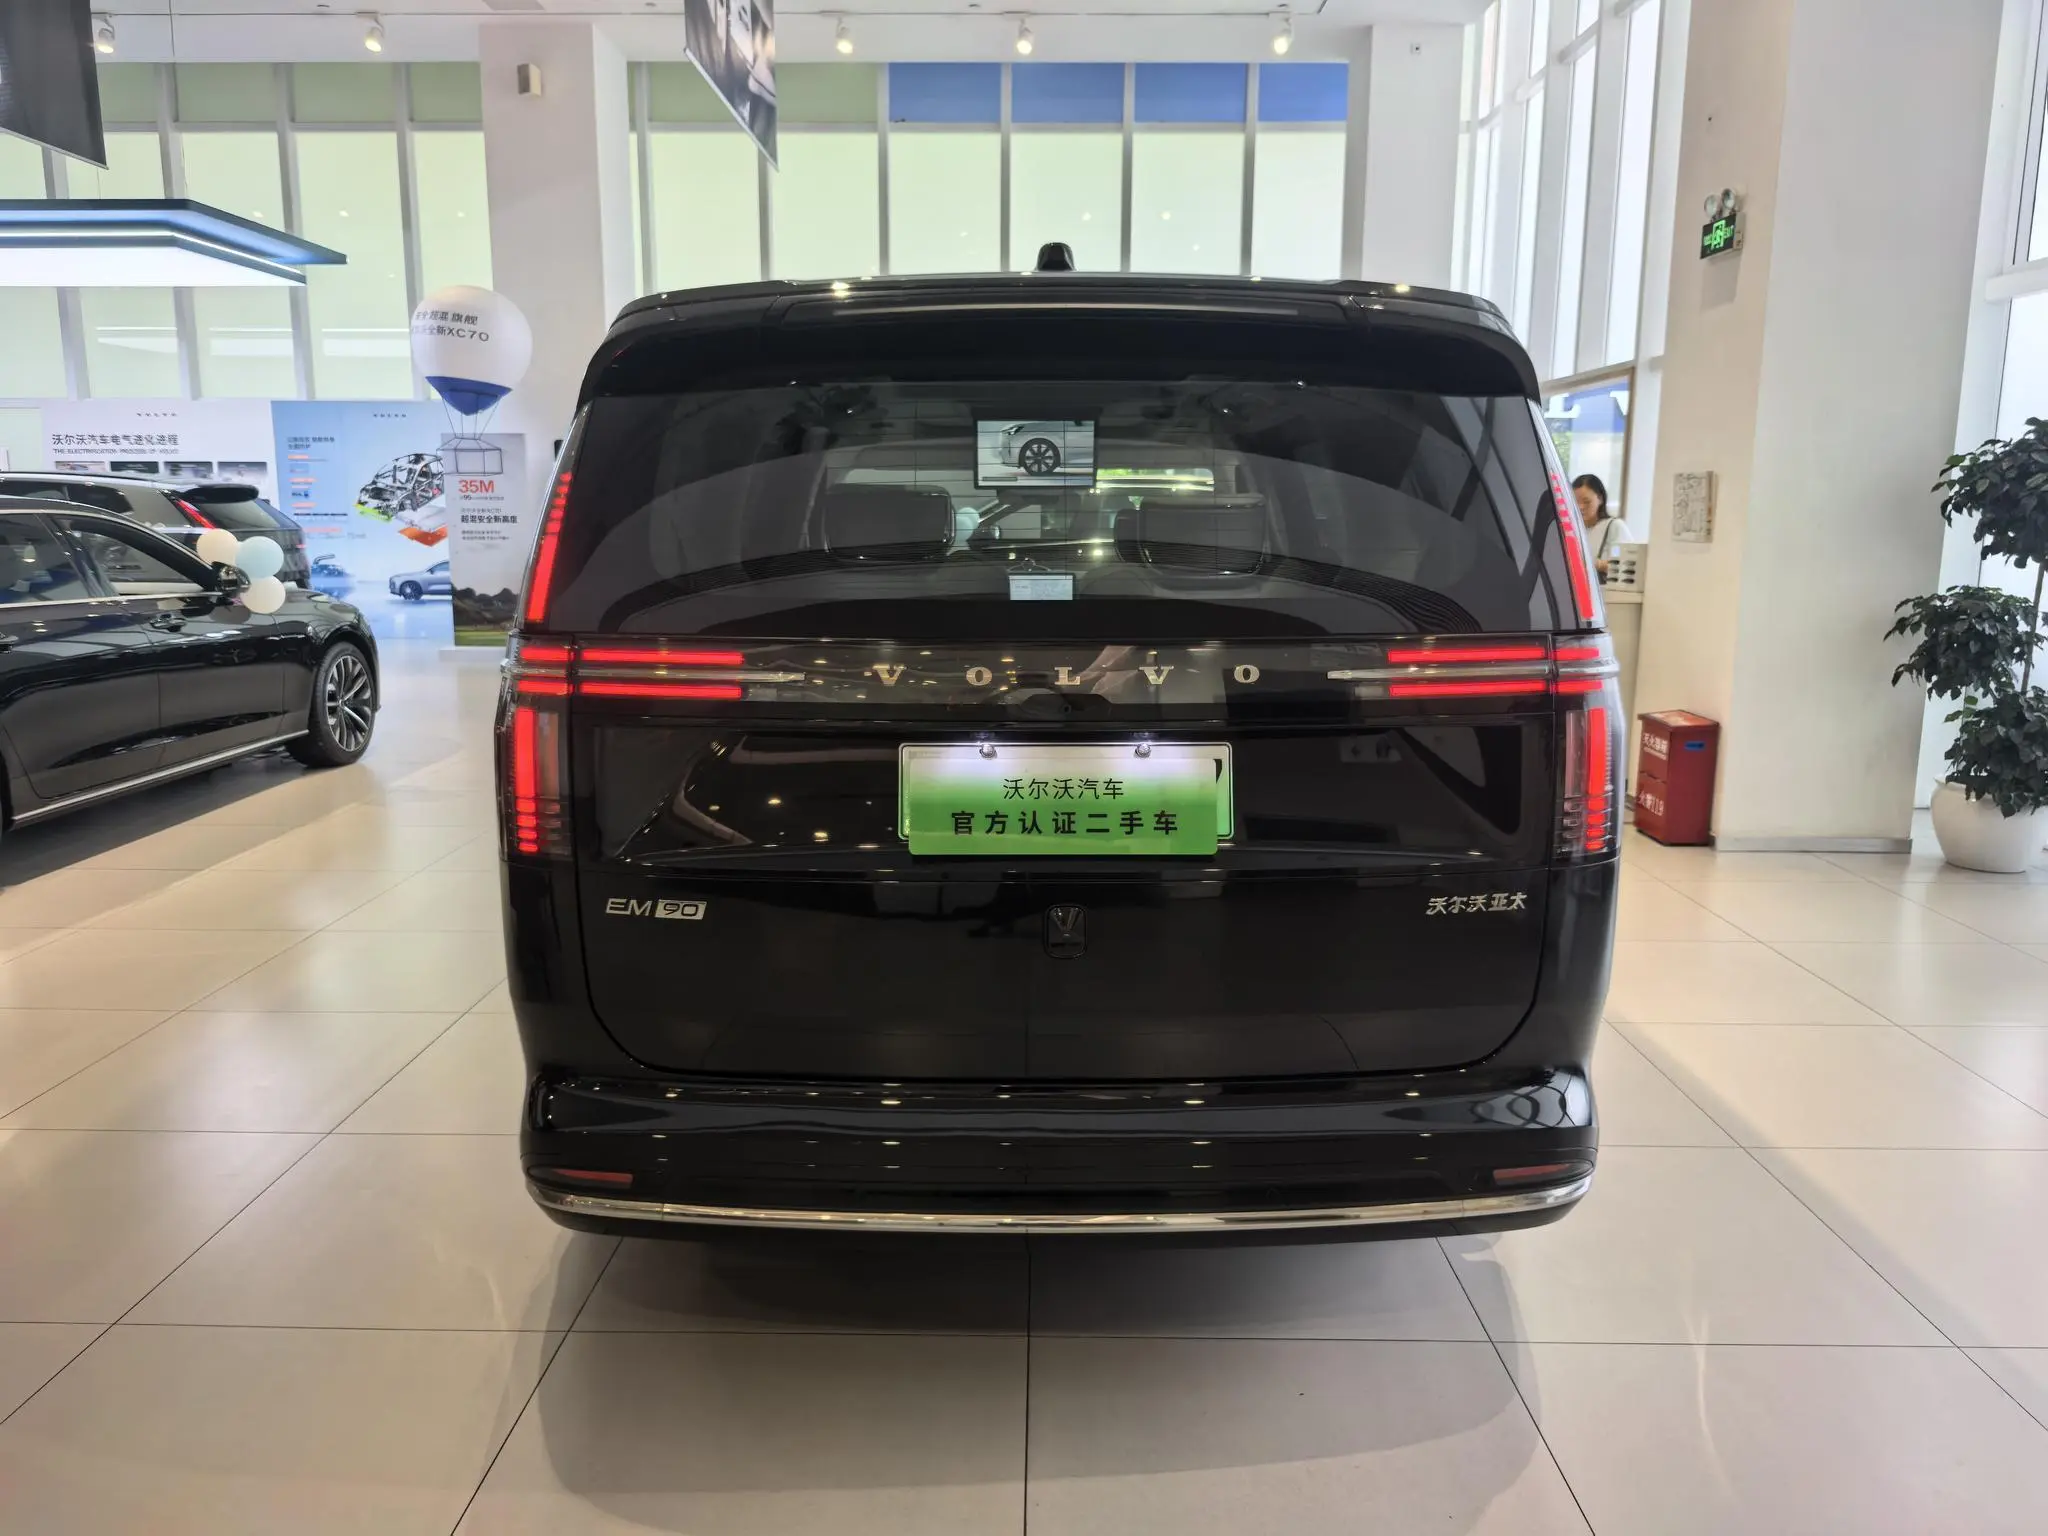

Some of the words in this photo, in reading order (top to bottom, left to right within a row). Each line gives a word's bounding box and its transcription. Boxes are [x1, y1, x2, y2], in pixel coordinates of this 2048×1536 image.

[458, 479, 495, 494] 35M
[872, 664, 1260, 686] VOLVO
[1003, 778, 1125, 800] 沃尔沃汽车
[951, 810, 1179, 836] 官方认证二手车
[605, 898, 708, 920] EM90
[1425, 891, 1528, 916] 沃尔沃亚太
